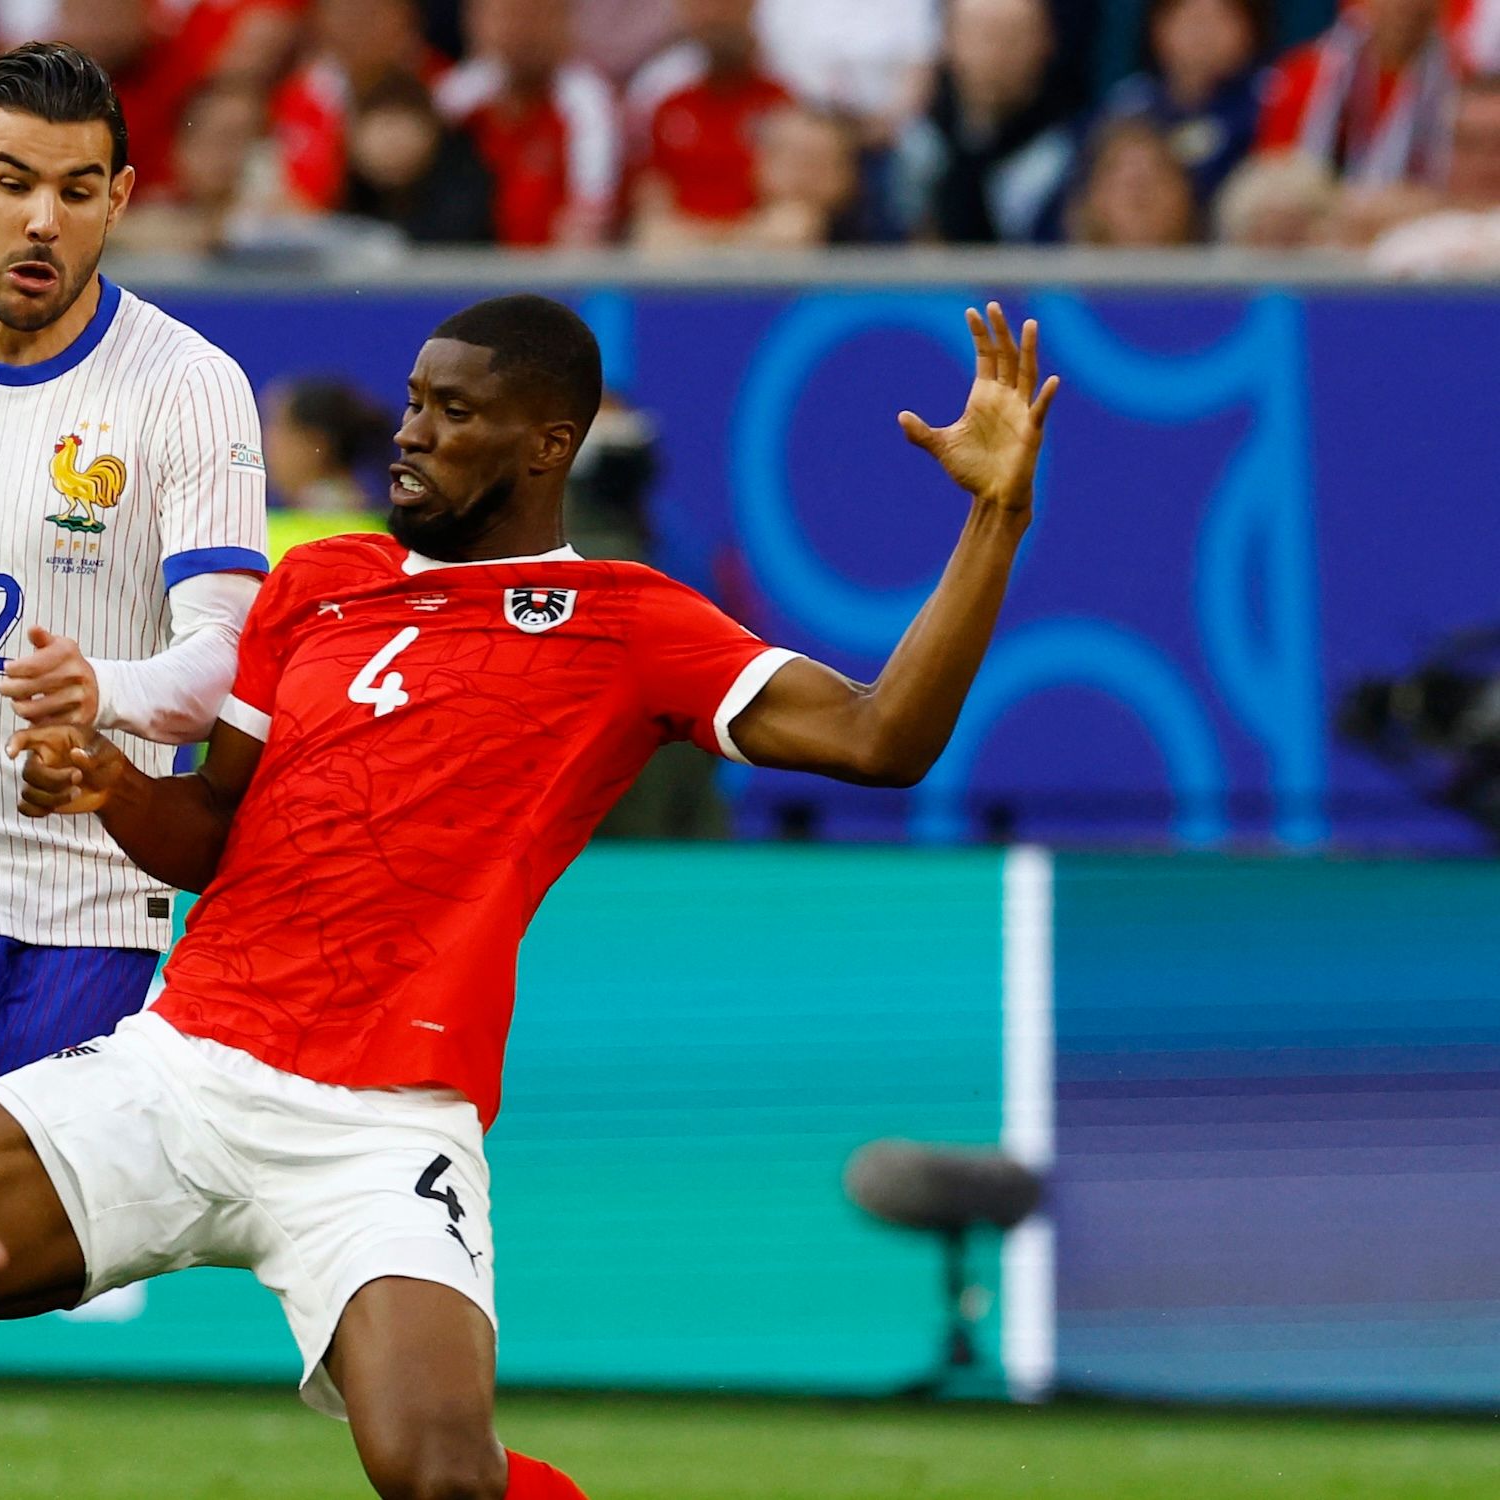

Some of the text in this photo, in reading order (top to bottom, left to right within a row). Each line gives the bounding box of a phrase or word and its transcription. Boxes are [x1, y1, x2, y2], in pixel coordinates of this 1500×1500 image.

[230, 450, 262, 465] FOUN
[347, 625, 420, 718] 4
[414, 1153, 466, 1223] 4
